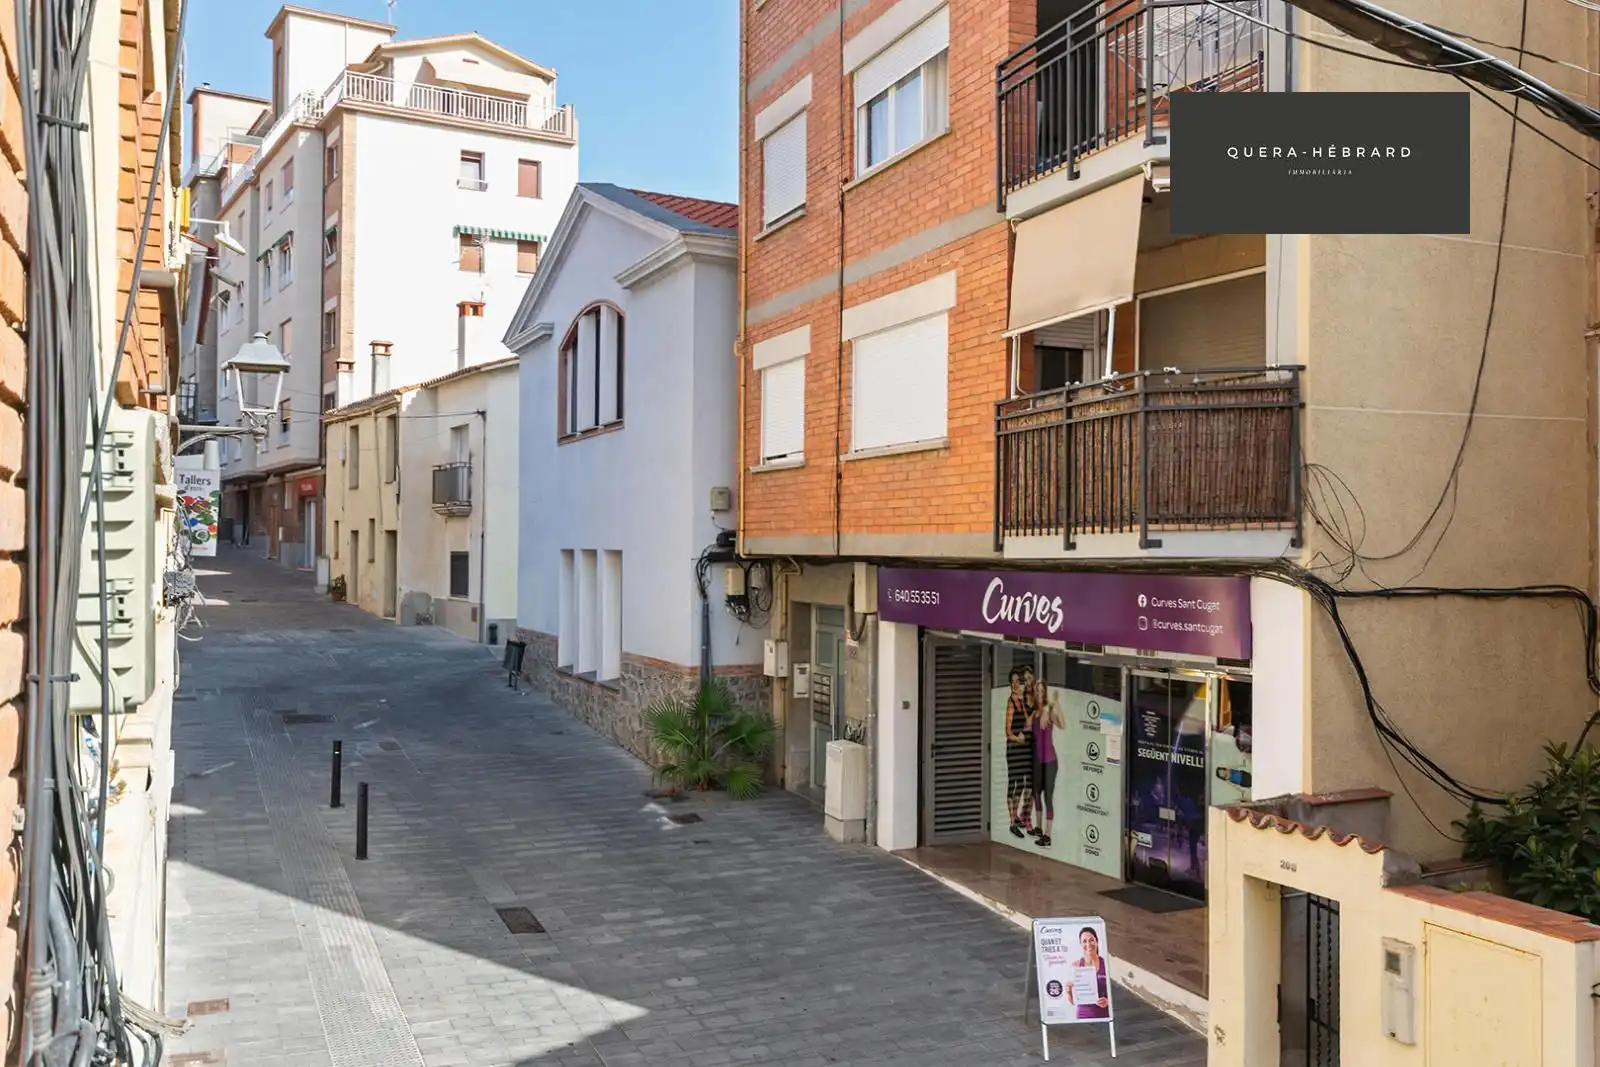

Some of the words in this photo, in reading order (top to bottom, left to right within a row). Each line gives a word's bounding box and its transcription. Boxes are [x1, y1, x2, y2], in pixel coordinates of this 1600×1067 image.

[179, 473, 212, 486] Tallers
[894, 588, 910, 603] 640
[982, 576, 1064, 634] Curves
[1150, 596, 1177, 609] Curves
[1177, 598, 1196, 610] Sant
[1196, 599, 1221, 613] Cugat
[1137, 747, 1169, 762] SEGÜENT
[1170, 752, 1204, 768] NIVELL!
